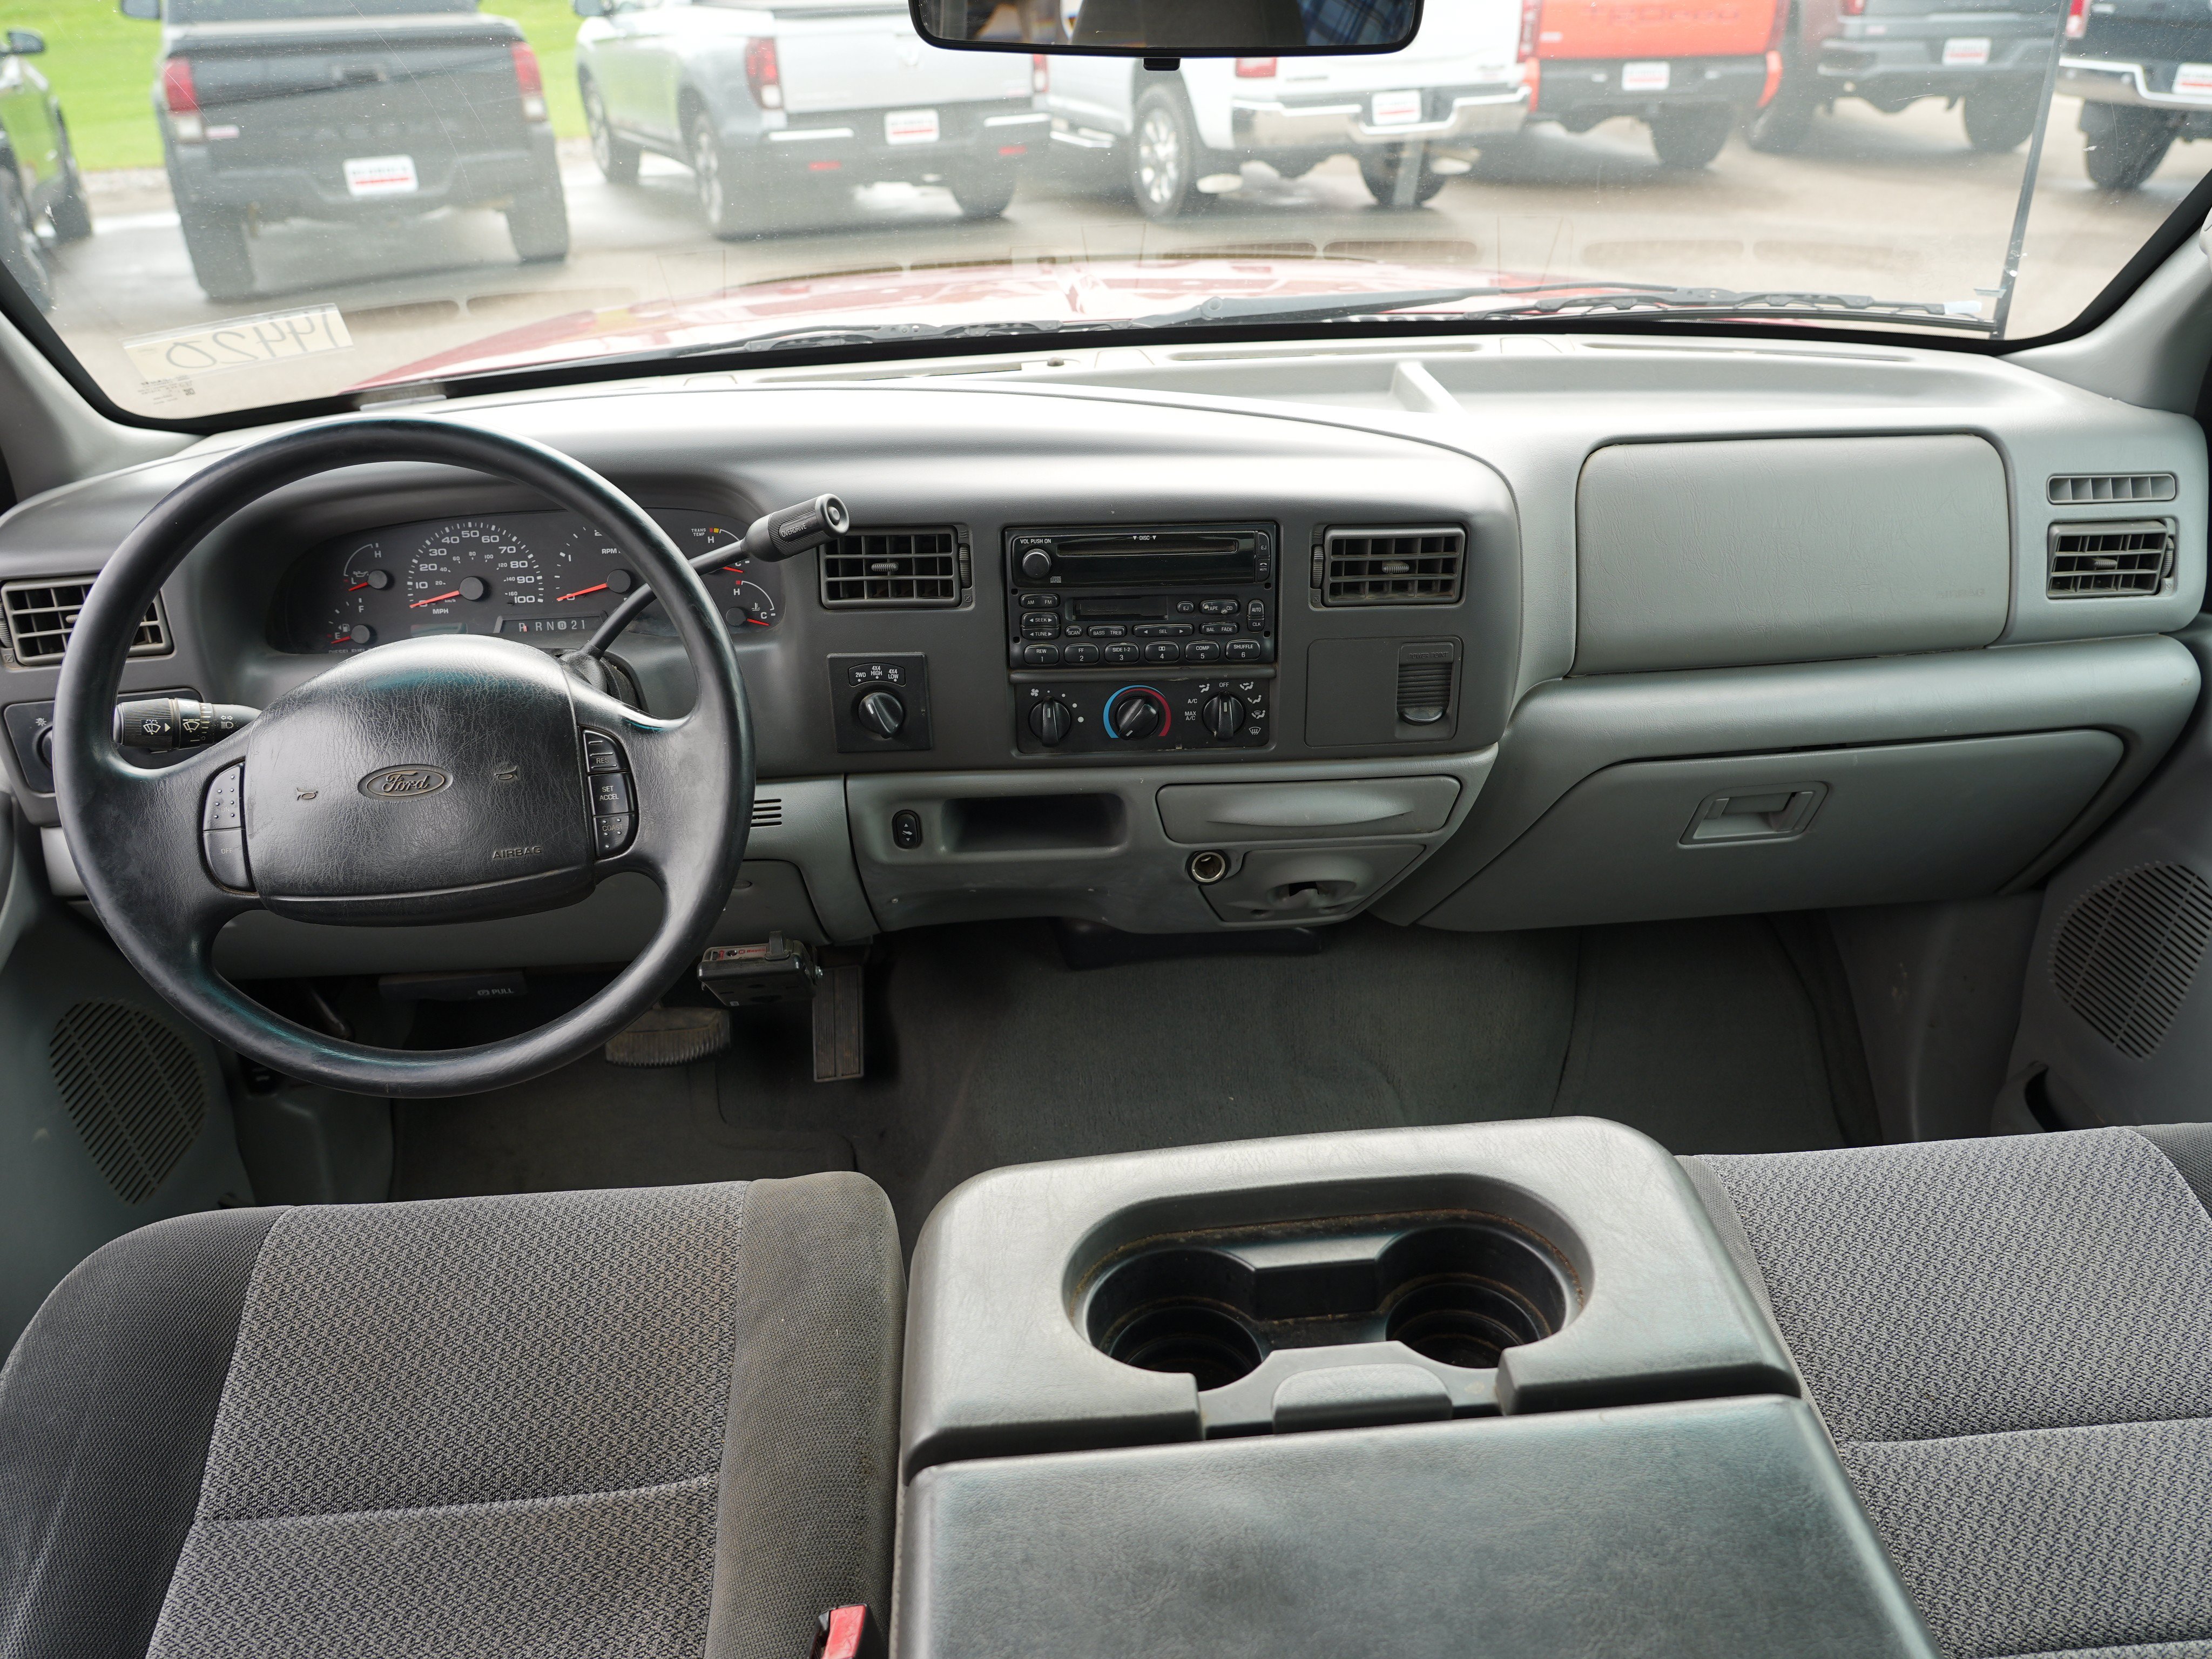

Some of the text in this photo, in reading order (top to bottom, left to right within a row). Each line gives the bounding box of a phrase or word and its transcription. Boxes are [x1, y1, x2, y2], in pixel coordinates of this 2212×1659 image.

[781, 523, 807, 537] OVERDRIVE
[481, 535, 500, 543] 60
[429, 548, 447, 556] 30
[420, 563, 437, 571] 20
[517, 576, 535, 584] 90
[415, 581, 428, 589] 10
[514, 596, 535, 604] 100
[760, 611, 767, 619] C
[518, 623, 526, 632] P
[535, 622, 542, 631] R
[547, 622, 555, 630] N
[571, 621, 577, 630] 2
[582, 620, 585, 629] 1
[382, 772, 430, 793] Ford
[493, 846, 542, 860] AIRBAG
